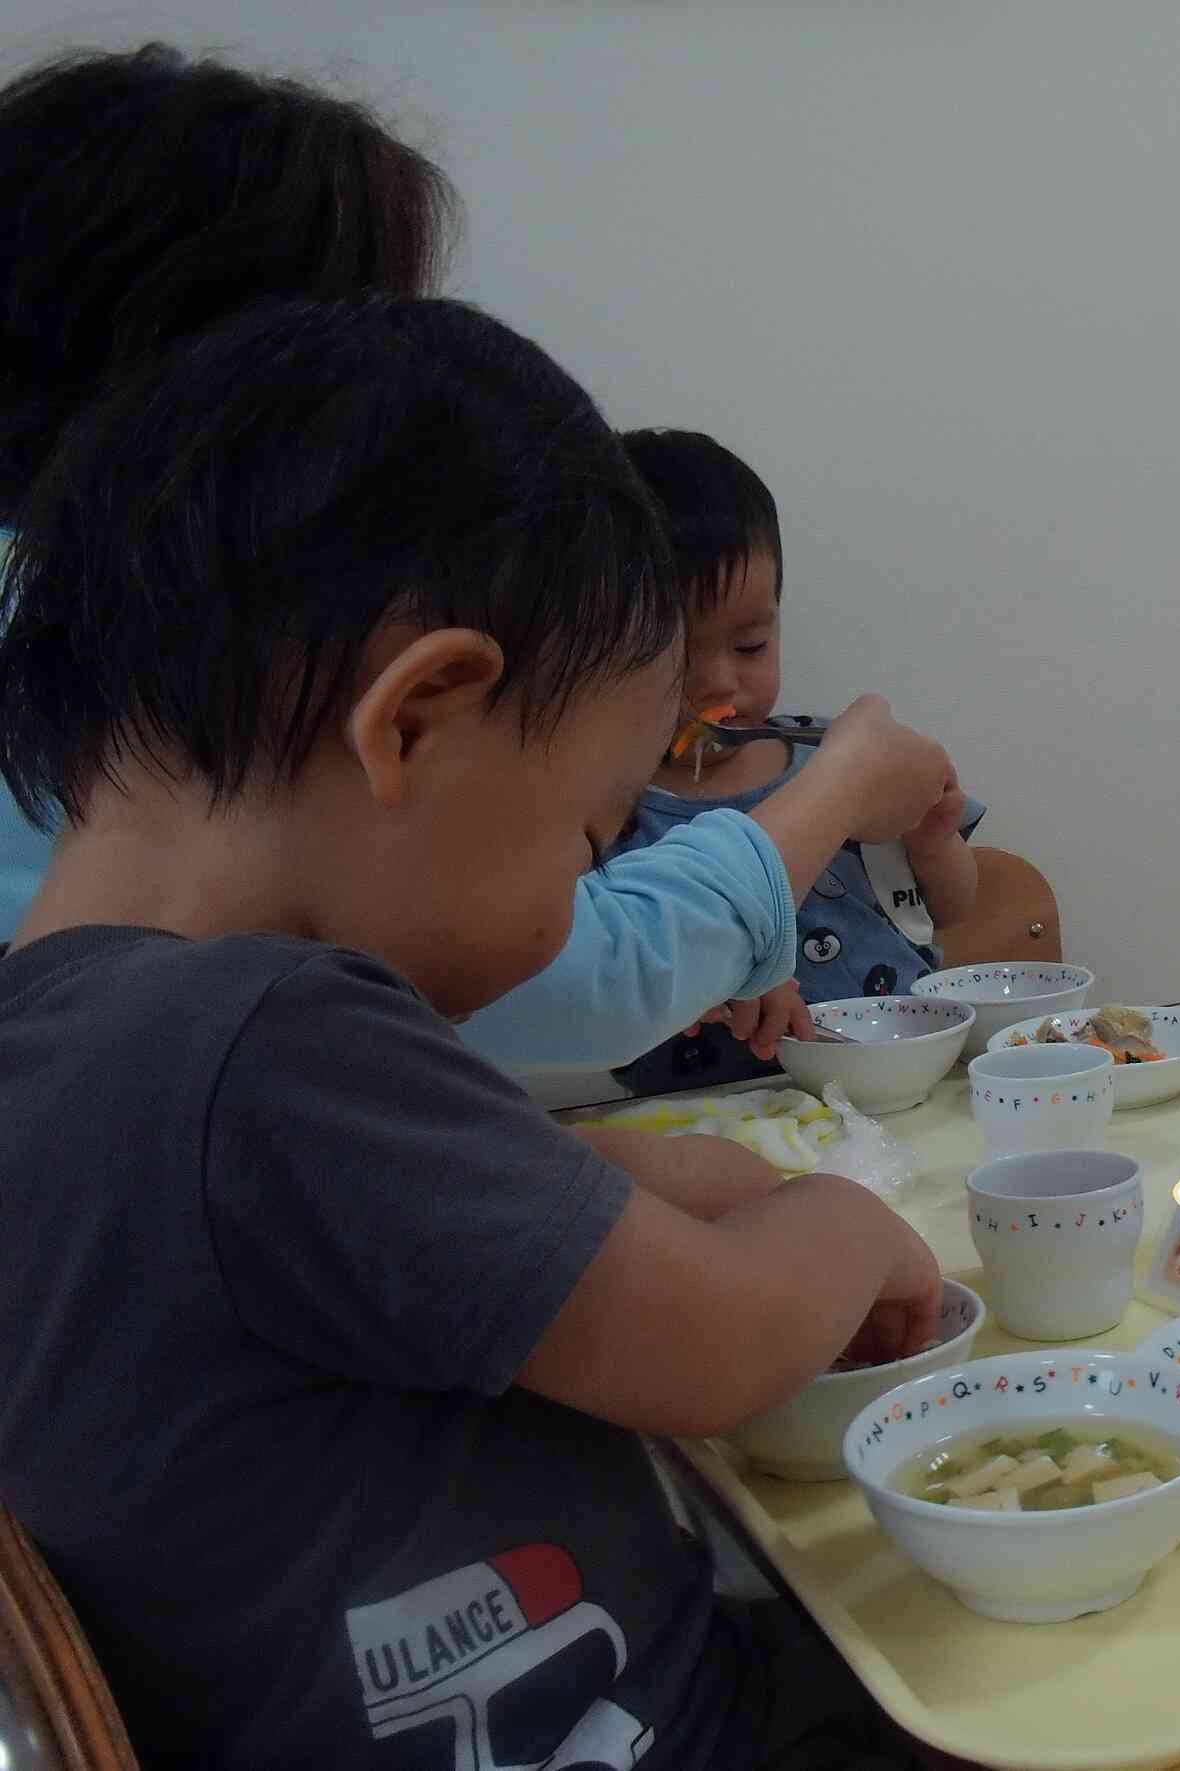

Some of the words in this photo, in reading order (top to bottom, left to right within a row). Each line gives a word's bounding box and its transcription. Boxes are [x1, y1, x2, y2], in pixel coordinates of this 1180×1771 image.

[1013, 1099, 1022, 1111] F
[1027, 1213, 1039, 1228] I
[1075, 1213, 1087, 1228] J
[920, 1401, 930, 1419] P
[952, 1381, 973, 1400] Q
[994, 1375, 1009, 1394] R
[1032, 1375, 1047, 1394] S
[1109, 1377, 1123, 1397] U
[1148, 1370, 1161, 1388] V
[364, 1590, 514, 1692] ULANCE
